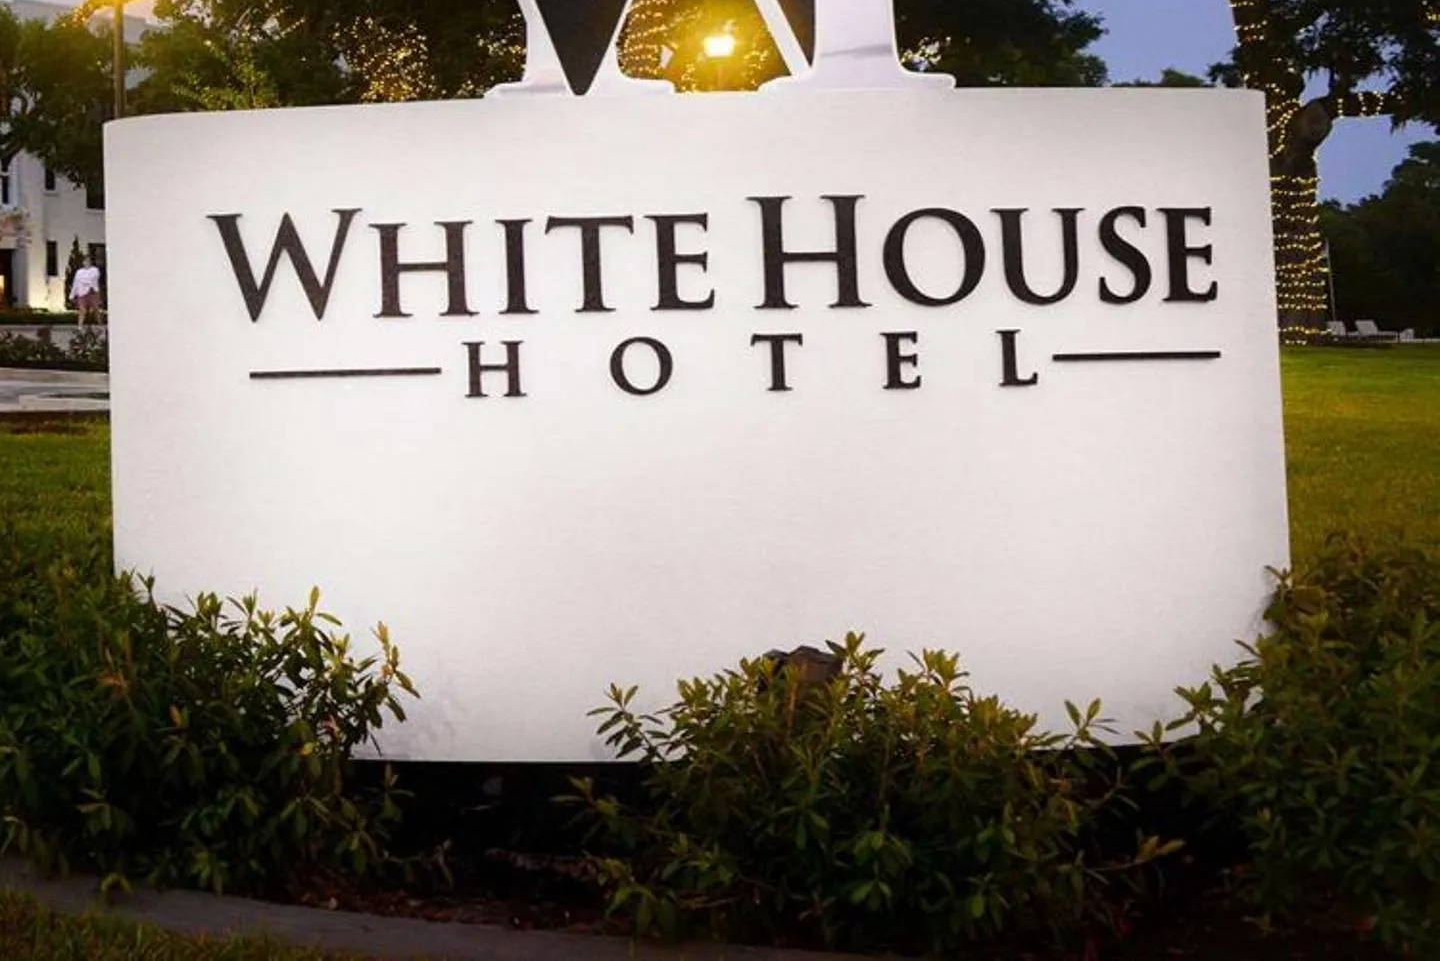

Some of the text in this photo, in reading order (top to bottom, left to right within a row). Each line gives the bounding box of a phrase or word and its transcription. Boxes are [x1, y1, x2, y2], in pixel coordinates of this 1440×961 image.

[206, 193, 1219, 323] WHITE HOUSE
[461, 328, 1039, 399] HOTEL
